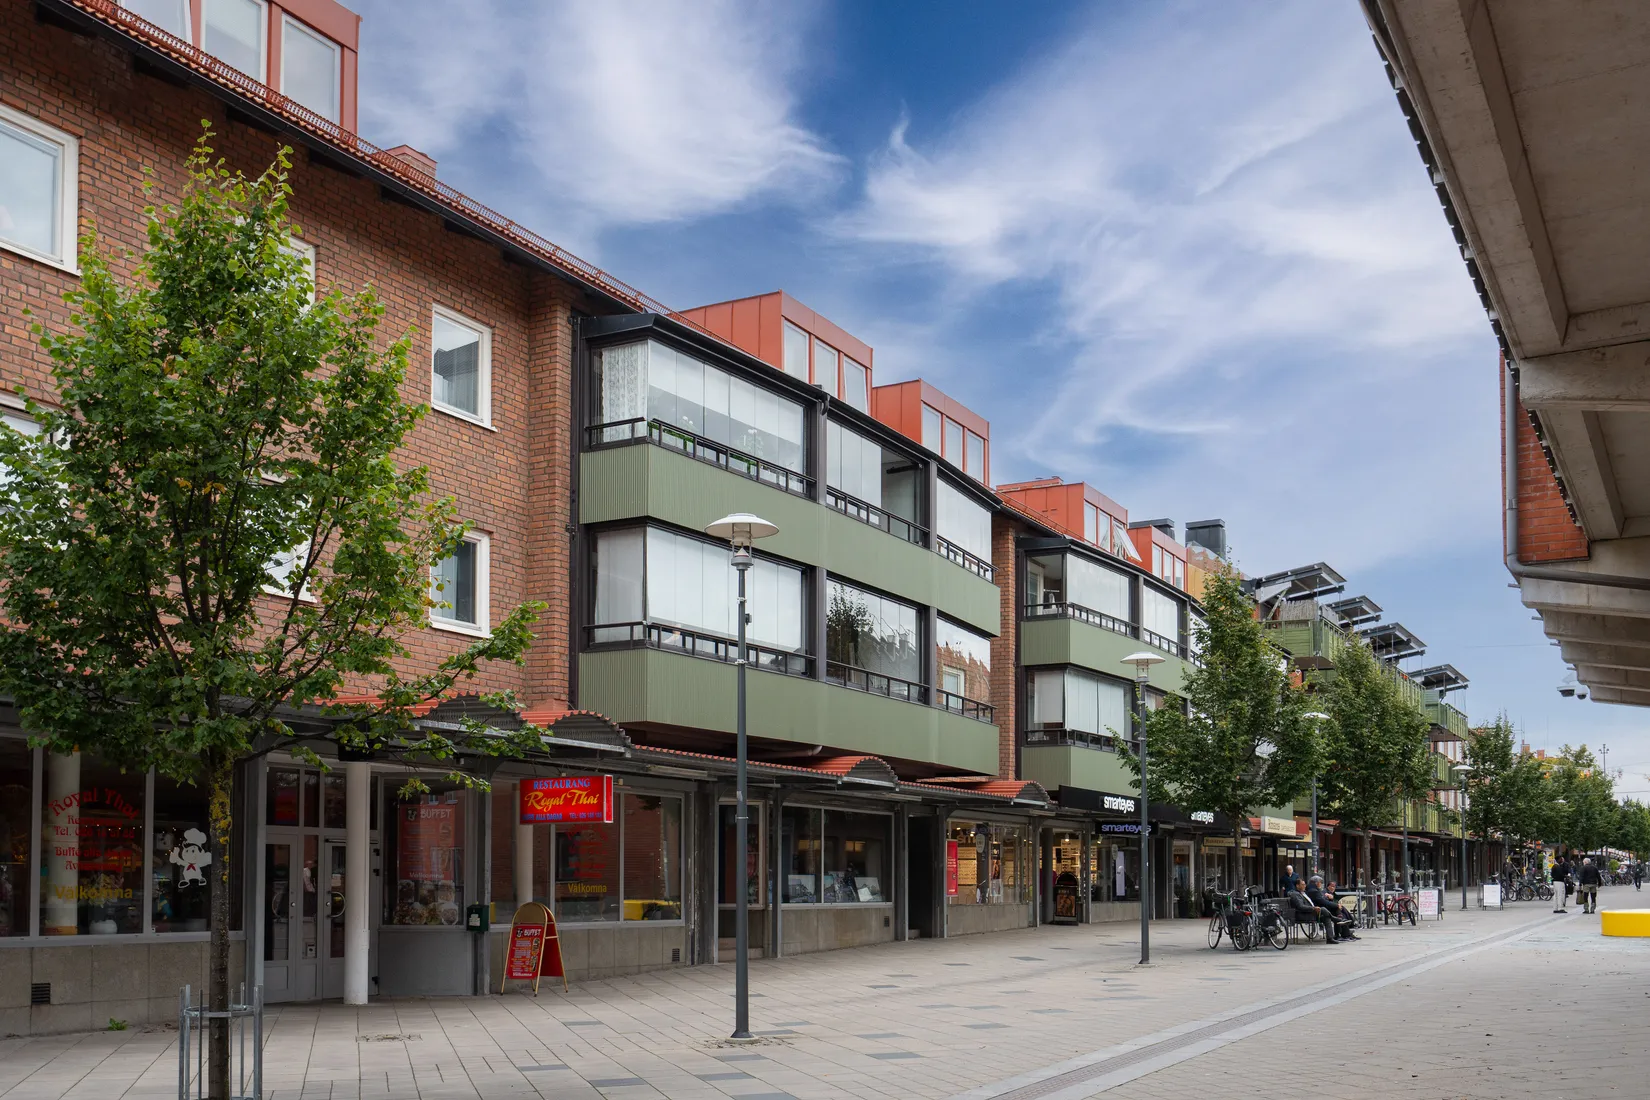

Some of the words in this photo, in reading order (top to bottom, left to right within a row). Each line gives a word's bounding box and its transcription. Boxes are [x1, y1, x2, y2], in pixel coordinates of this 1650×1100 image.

[533, 778, 591, 790] RESTAURANG
[48, 786, 97, 817] Royal
[104, 787, 140, 820] Thai
[524, 790, 567, 812] Royal
[567, 789, 600, 806] Thai
[1103, 796, 1135, 814] smarteyes
[420, 808, 452, 819] BUFFET
[54, 885, 133, 900] Välkomna
[567, 883, 607, 893] Välkomna
